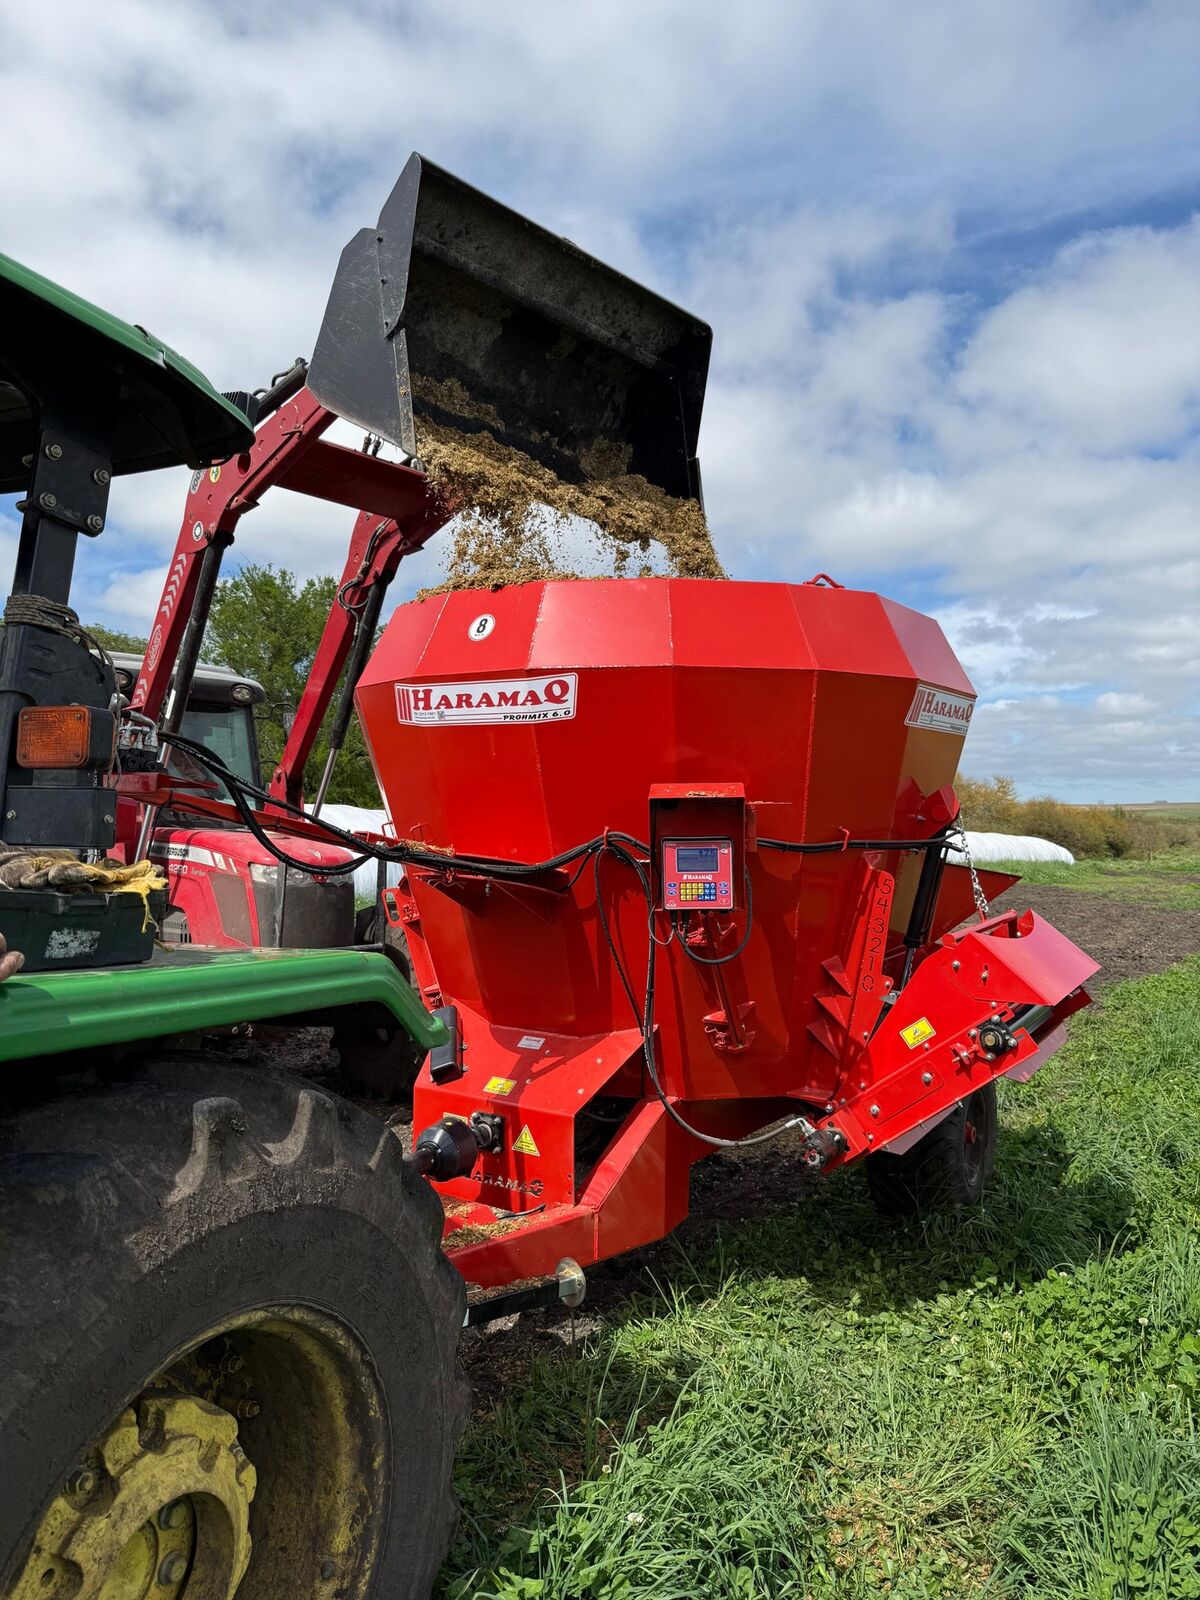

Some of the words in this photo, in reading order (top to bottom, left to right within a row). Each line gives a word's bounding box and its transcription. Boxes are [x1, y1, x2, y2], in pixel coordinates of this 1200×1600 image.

[476, 618, 488, 634] 8
[411, 679, 570, 711] HARAMAQ
[503, 712, 549, 721] PROHMIX
[552, 709, 571, 717] 6.0
[922, 691, 974, 723] HARAMAQ
[879, 878, 892, 895] 5
[877, 897, 889, 915] 4
[872, 917, 885, 934] 3
[871, 938, 882, 954] 2
[862, 974, 875, 992] 0
[470, 1170, 545, 1197] ARAMAQ
